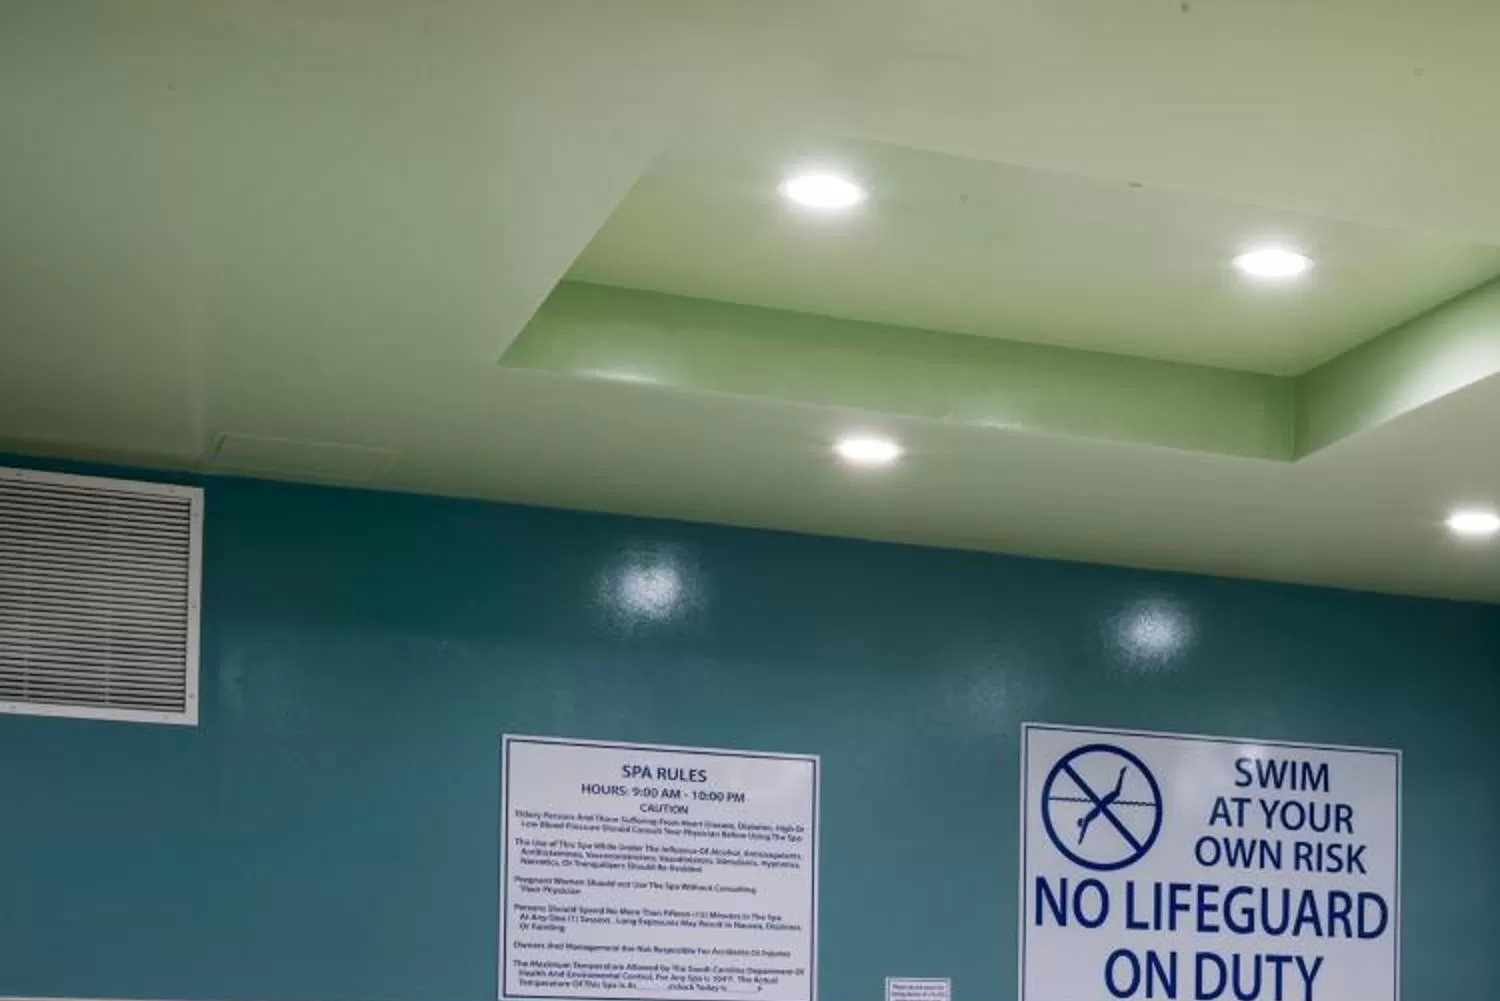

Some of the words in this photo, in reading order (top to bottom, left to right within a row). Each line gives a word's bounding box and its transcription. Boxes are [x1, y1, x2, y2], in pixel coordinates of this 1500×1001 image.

[621, 764, 652, 779] SPA
[657, 767, 708, 783] RULES
[1234, 758, 1330, 793] SWIM
[581, 783, 628, 797] HOURS:
[631, 787, 659, 799] 9:00
[661, 788, 681, 800] AM
[692, 790, 724, 801] 10:00
[726, 792, 745, 803] PM
[640, 803, 689, 815] CAUTION
[1208, 797, 1252, 828] AT
[1260, 800, 1355, 835] YOUR
[1194, 836, 1282, 871] OWN
[1293, 842, 1367, 875] RISK
[1034, 876, 1110, 929] NO
[1125, 881, 1389, 940] LIFEGUARD
[1105, 948, 1177, 1000] ON
